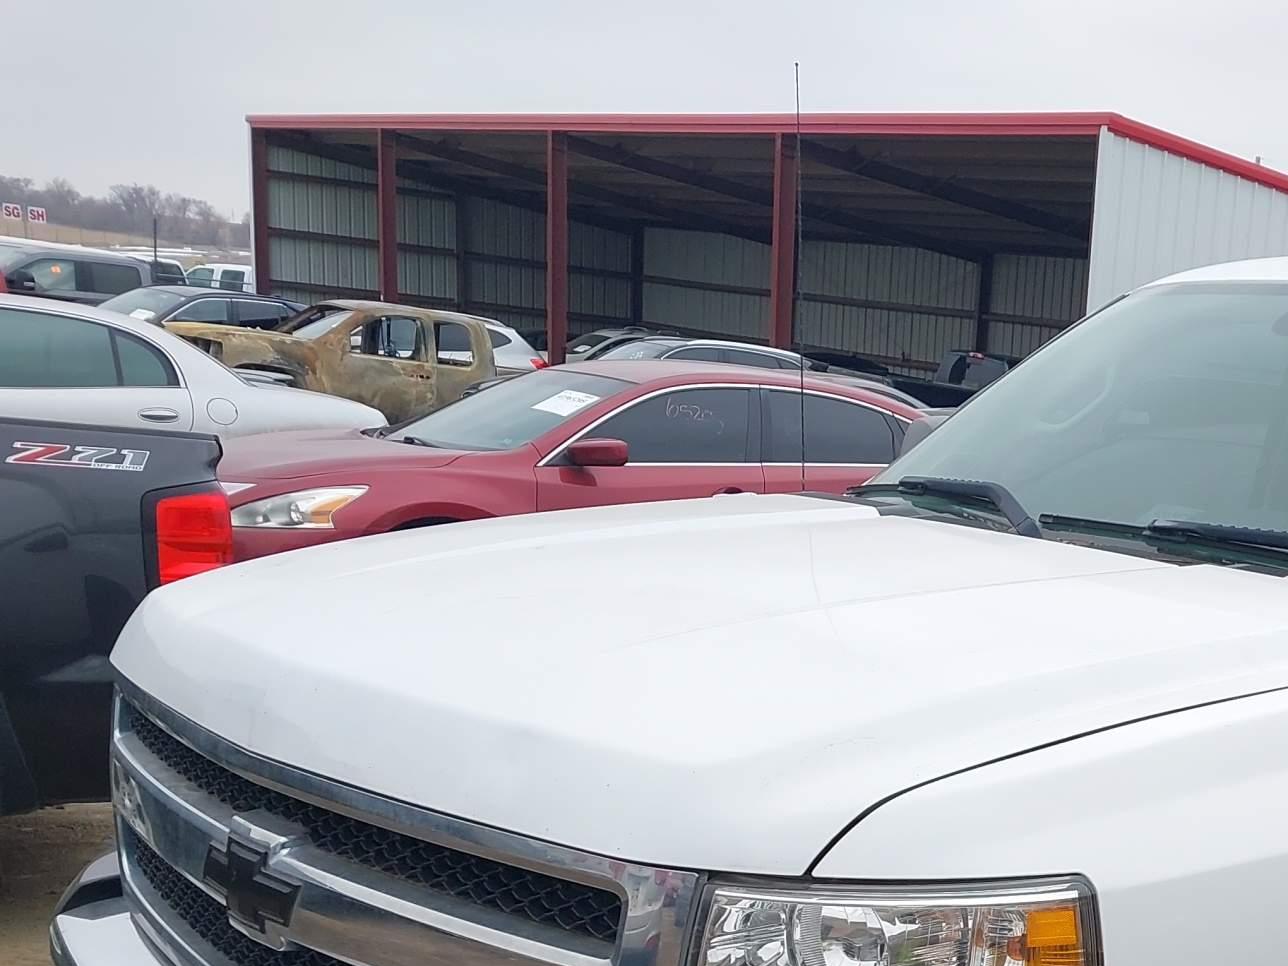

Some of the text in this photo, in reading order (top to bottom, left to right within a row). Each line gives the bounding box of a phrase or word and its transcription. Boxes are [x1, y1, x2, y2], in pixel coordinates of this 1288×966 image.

[4, 205, 21, 218] SG
[29, 209, 45, 222] SH
[5, 441, 151, 468] Z71
